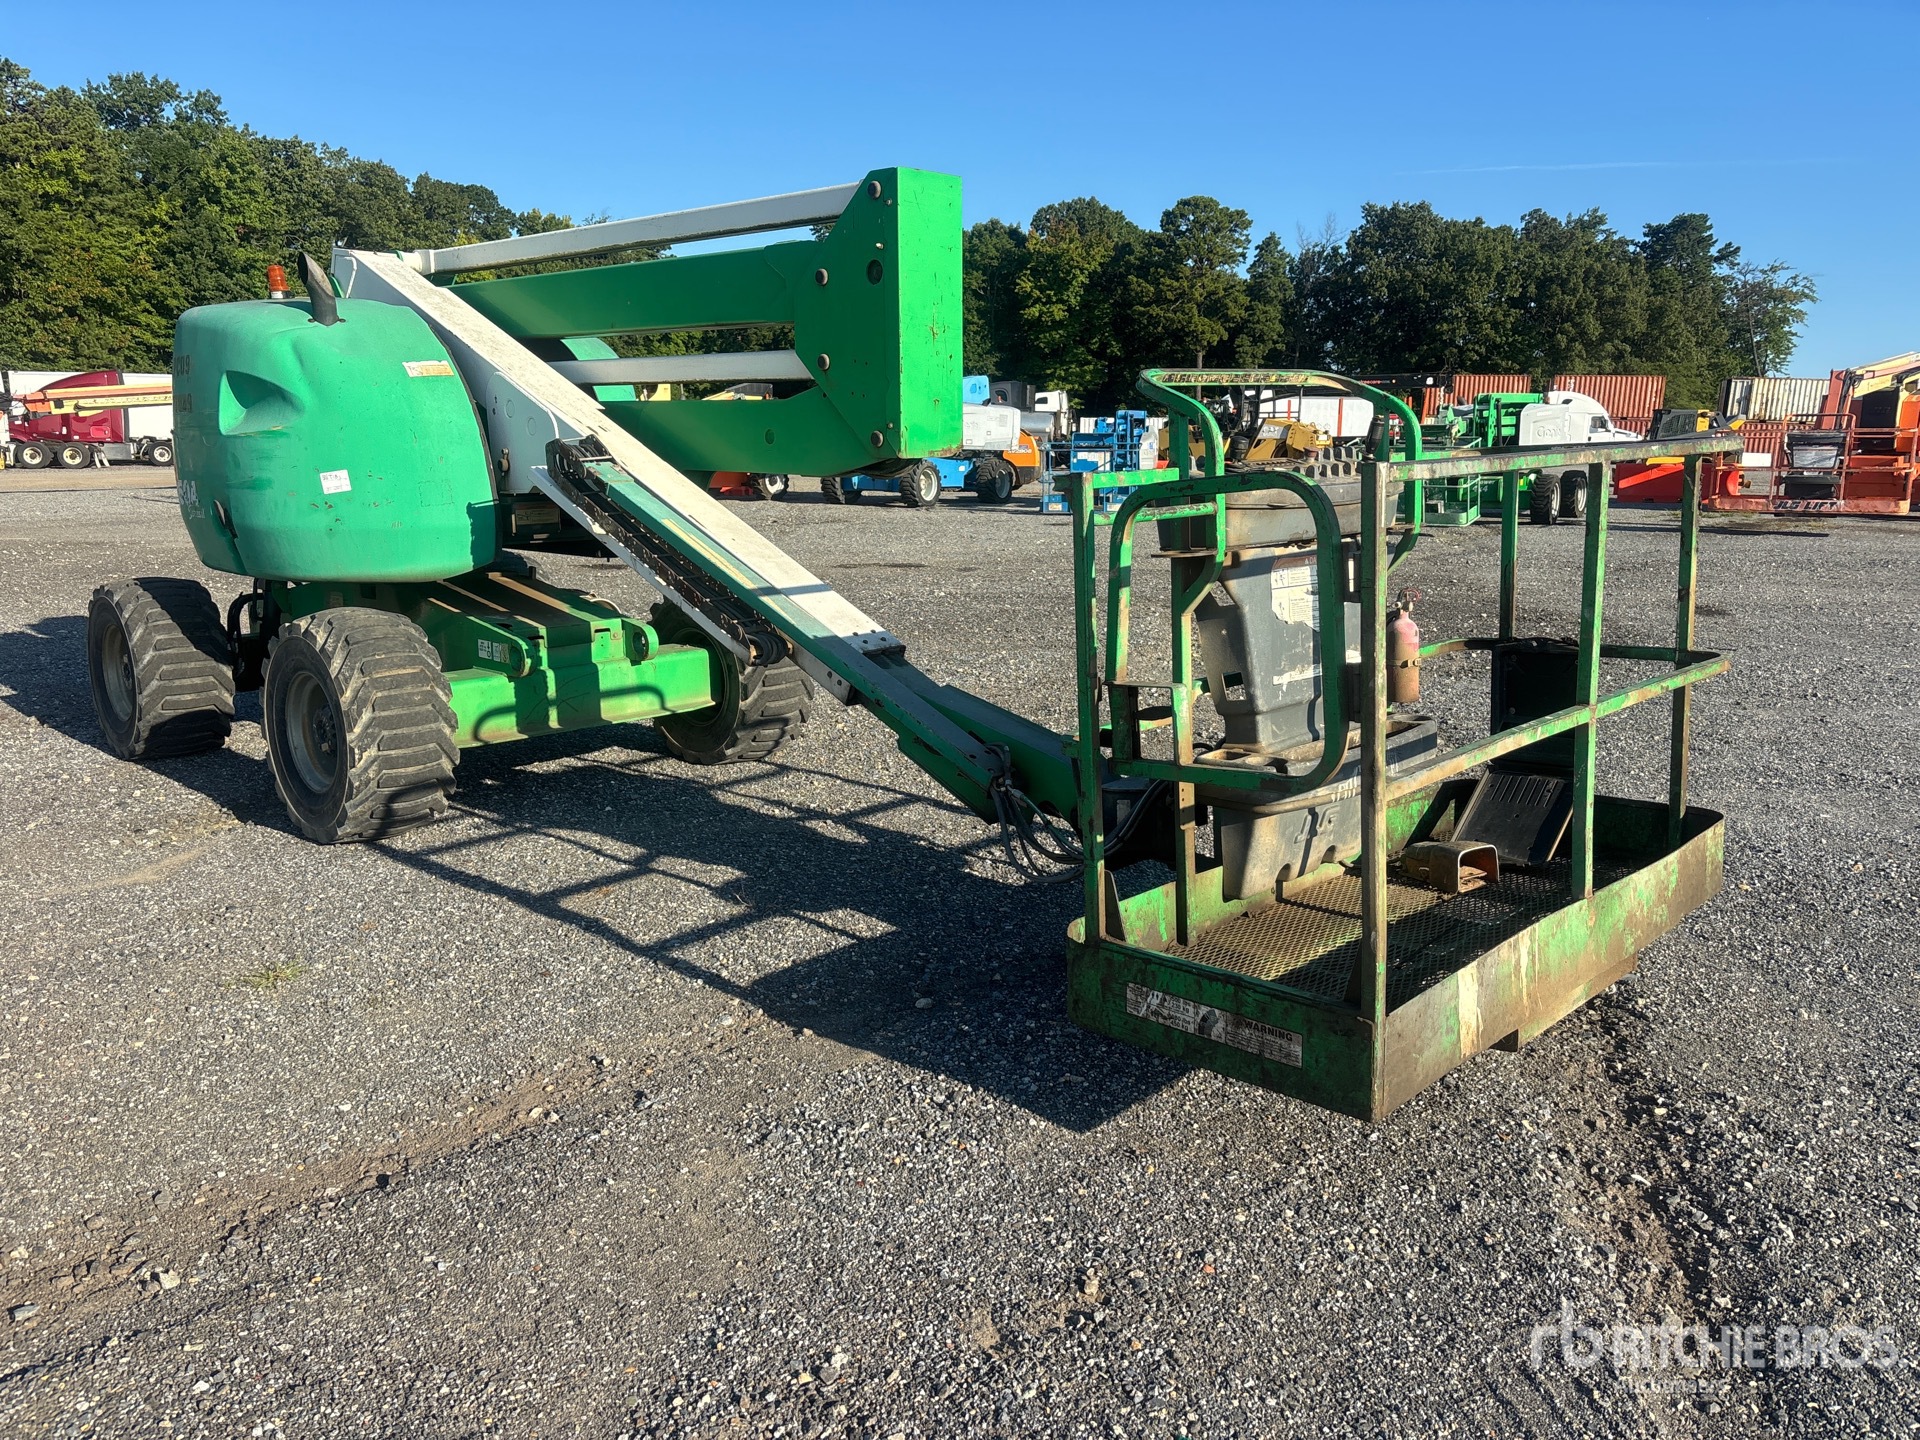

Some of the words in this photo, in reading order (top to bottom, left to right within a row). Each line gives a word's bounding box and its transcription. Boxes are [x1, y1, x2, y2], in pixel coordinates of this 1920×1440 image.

[1773, 500, 1801, 510] JLG
[1804, 501, 1838, 510] LIFT
[1244, 1019, 1293, 1042] WARNING
